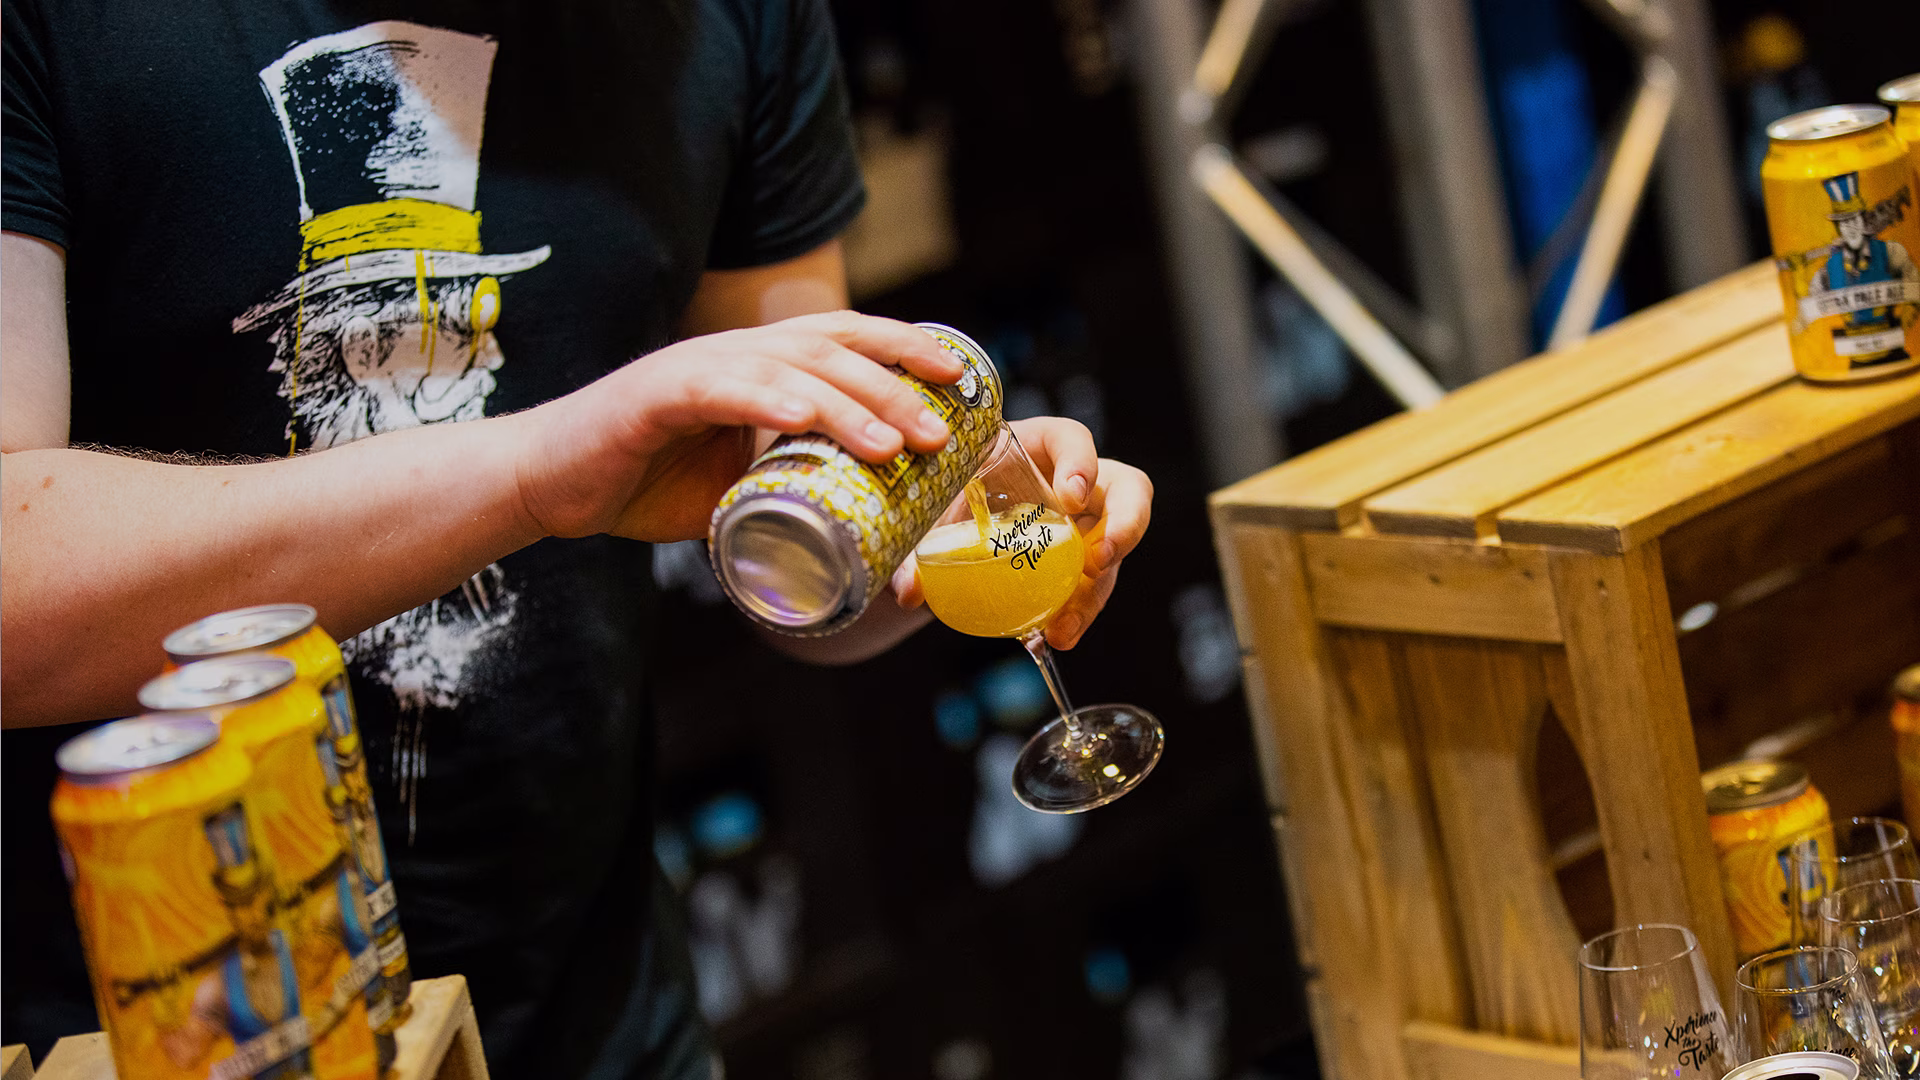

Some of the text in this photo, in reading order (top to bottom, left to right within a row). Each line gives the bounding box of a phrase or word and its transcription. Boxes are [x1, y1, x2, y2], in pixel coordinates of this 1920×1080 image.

[989, 502, 1046, 558] Xperience
[1010, 524, 1054, 571] Taste
[1011, 539, 1027, 554] the
[1663, 1011, 1717, 1049] Xperience
[1682, 1036, 1697, 1049] the
[1678, 1031, 1719, 1072] Taste
